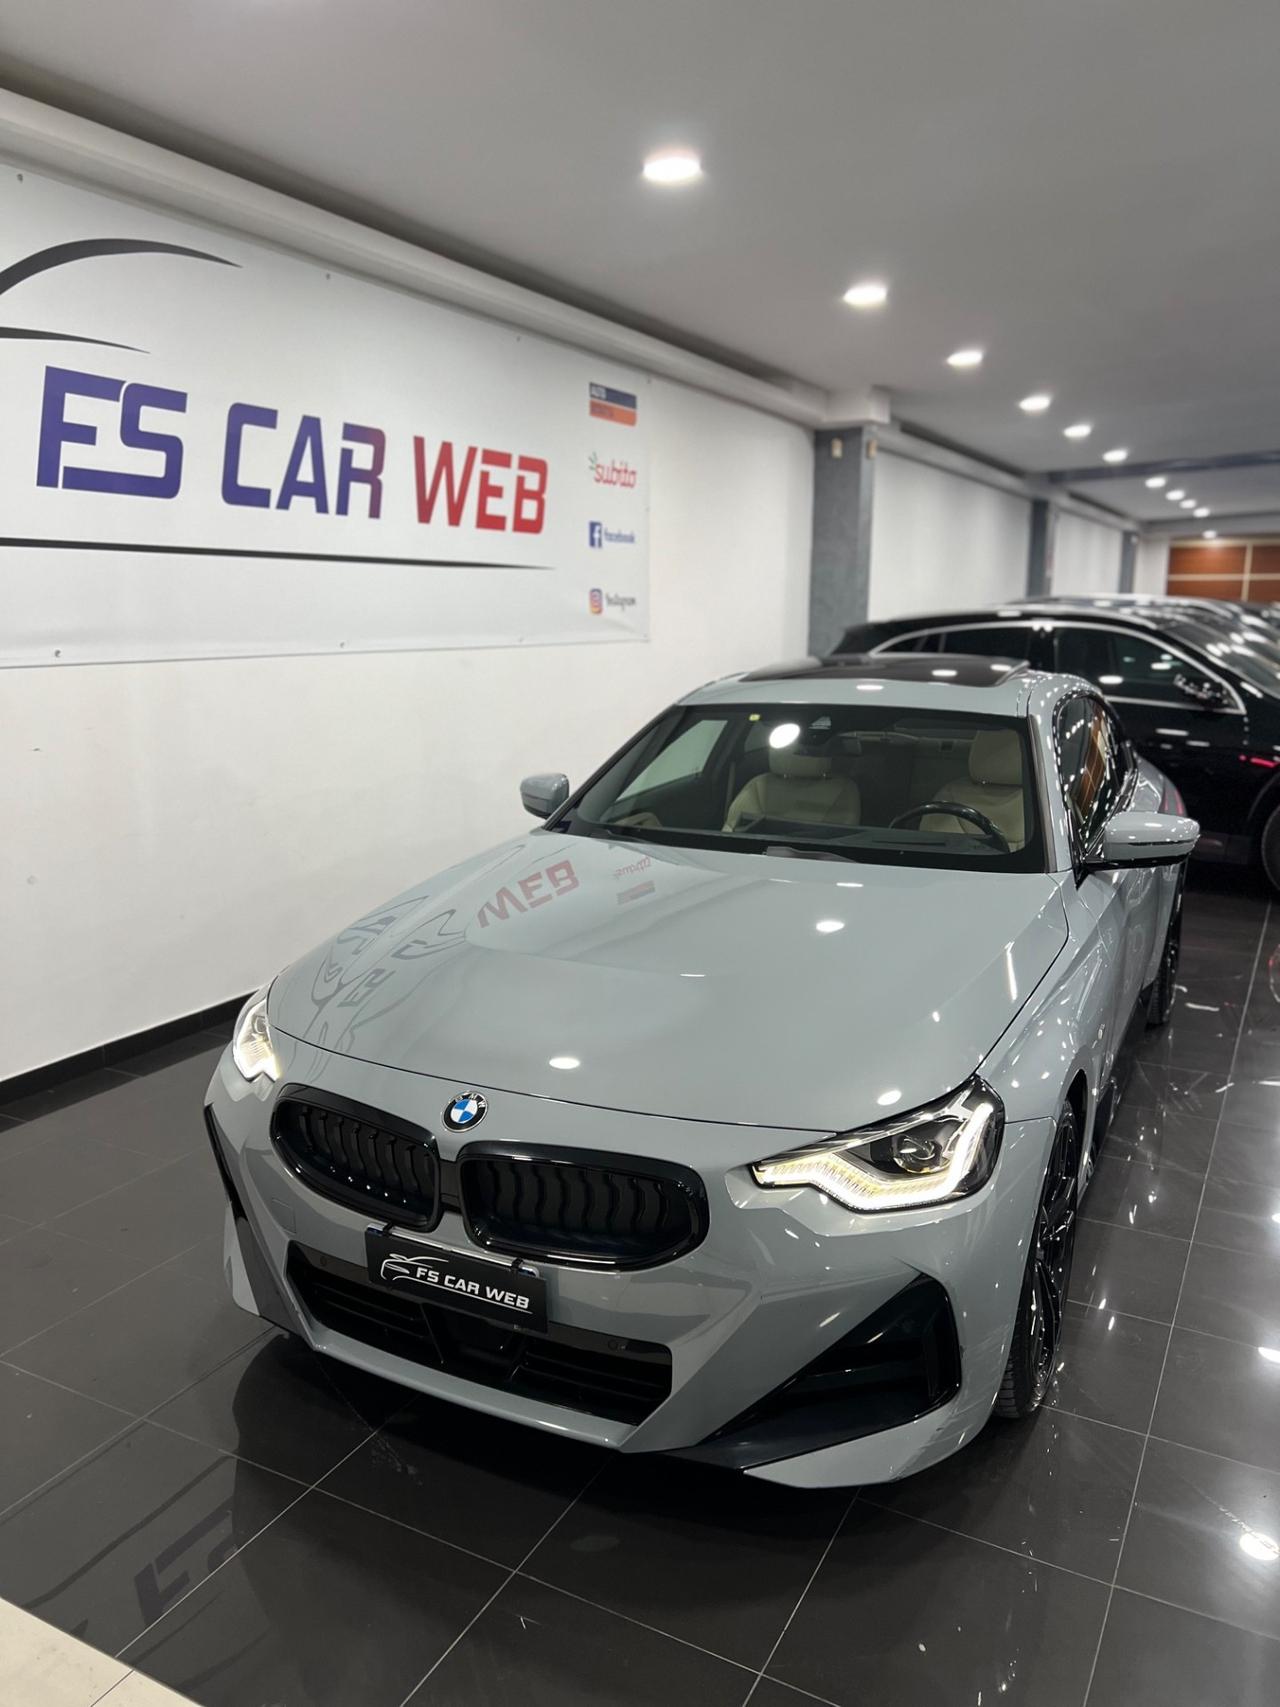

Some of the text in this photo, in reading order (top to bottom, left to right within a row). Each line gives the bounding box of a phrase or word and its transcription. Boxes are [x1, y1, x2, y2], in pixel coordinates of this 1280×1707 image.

[36, 364, 549, 535] FS CAR WEB
[595, 459, 637, 488] subito
[416, 1267, 530, 1310] FS CAR WEB
